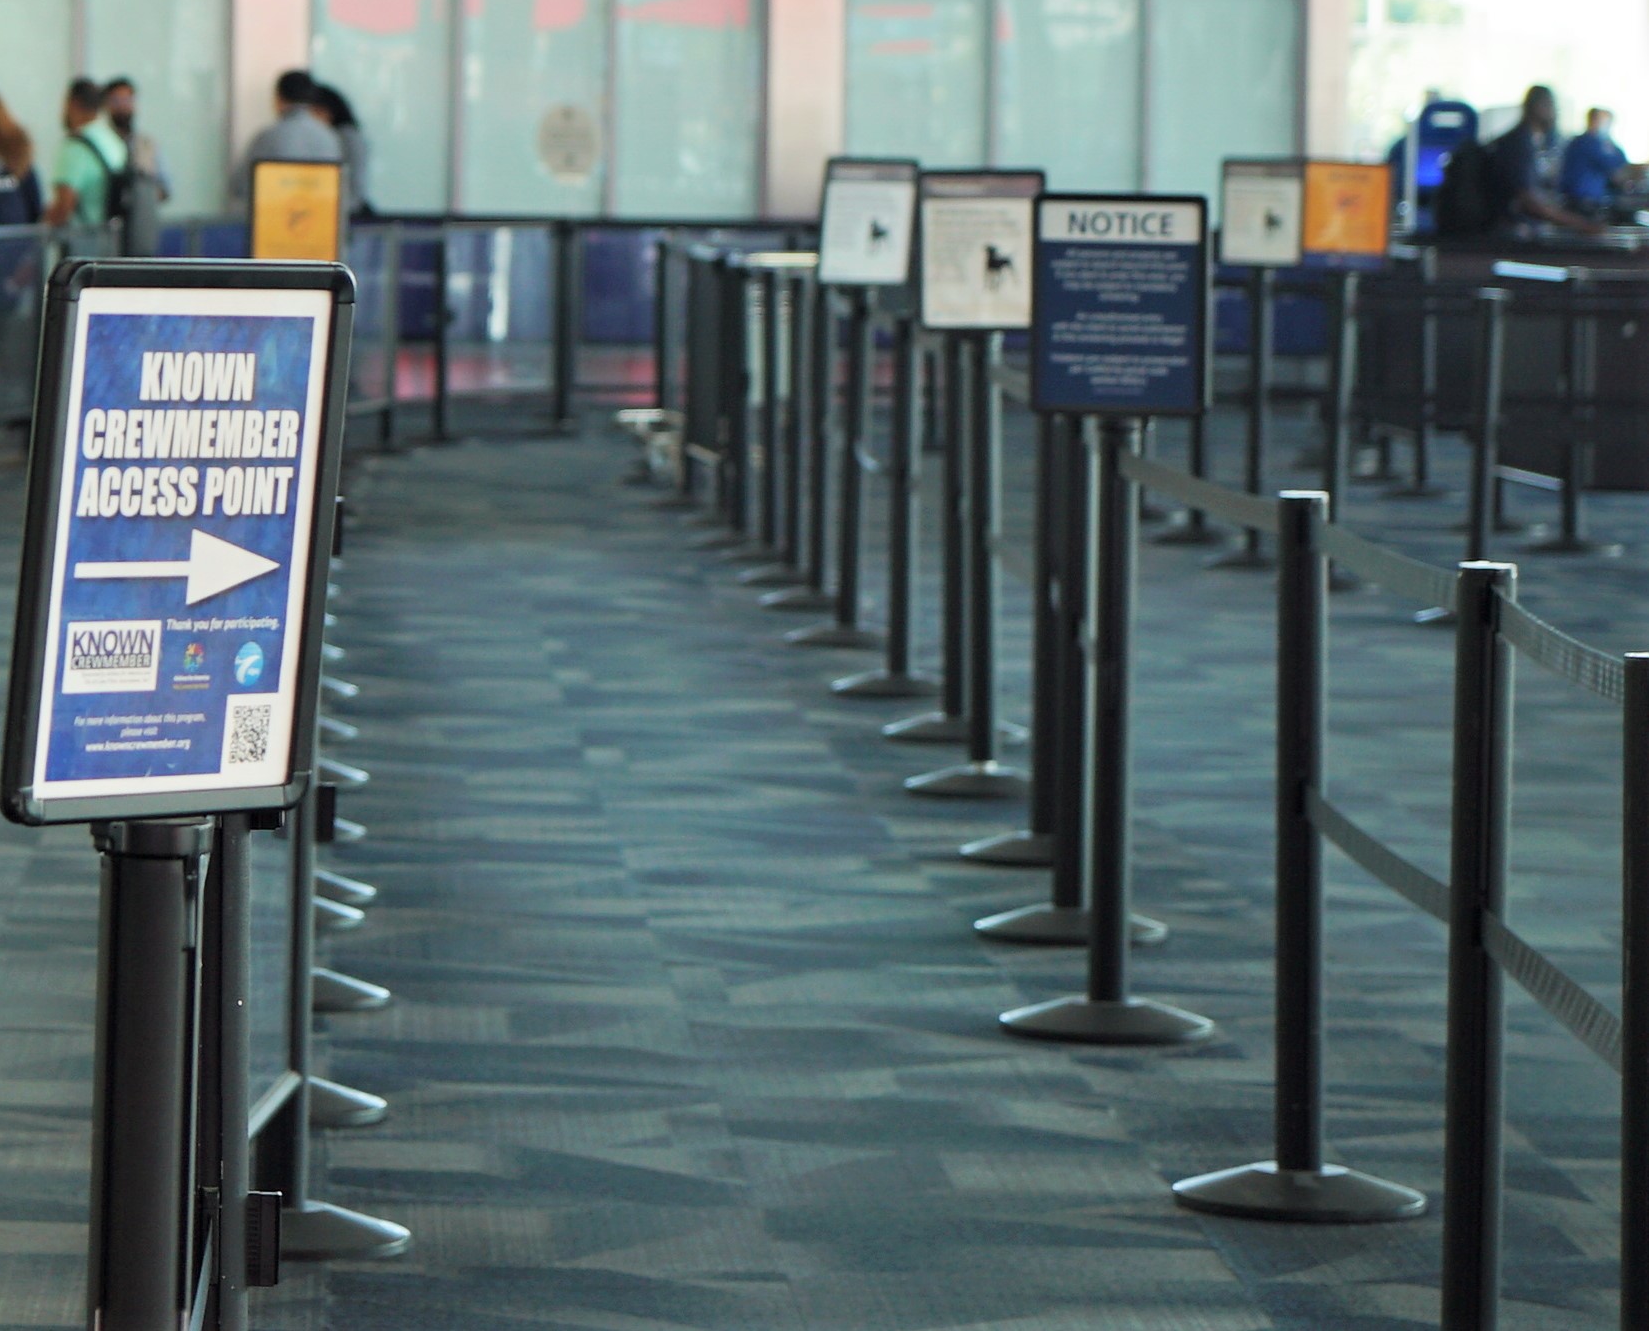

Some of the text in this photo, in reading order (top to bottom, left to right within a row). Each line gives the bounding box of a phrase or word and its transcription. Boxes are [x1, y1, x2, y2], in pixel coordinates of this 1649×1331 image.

[1068, 211, 1174, 237] NOTICE
[138, 351, 256, 402] KNOWN
[81, 408, 300, 460] CREWMEMBER
[75, 466, 294, 518] ACCESS POINT
[166, 616, 280, 633] Thank you for participating.
[72, 628, 154, 657] KNOWN
[71, 653, 152, 670] CREWMEMBER
